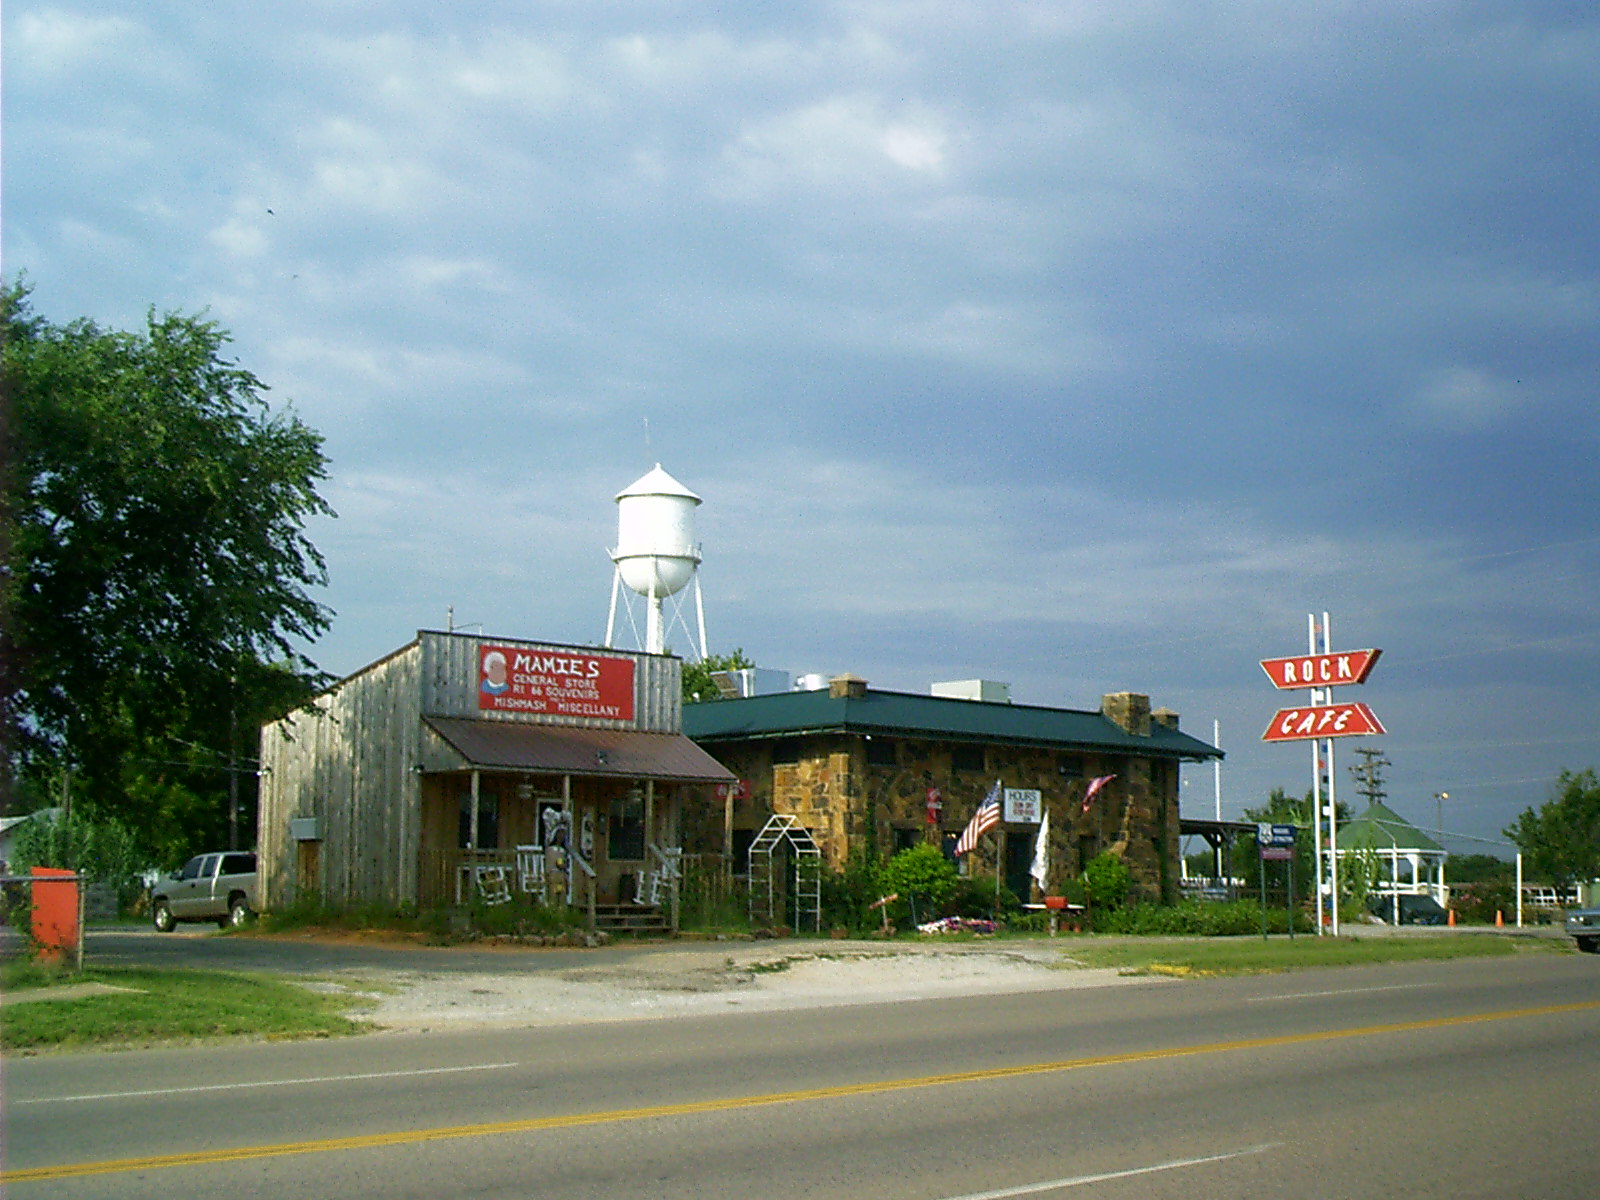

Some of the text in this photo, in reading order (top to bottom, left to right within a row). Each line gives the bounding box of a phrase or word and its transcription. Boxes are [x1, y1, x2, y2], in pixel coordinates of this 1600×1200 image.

[513, 653, 600, 678] MAMIES
[1284, 656, 1352, 683] ROCK
[531, 686, 543, 697] 66
[545, 687, 600, 700] SOUVENIRS
[565, 678, 596, 690] STORE
[494, 697, 547, 711] MISHMASH
[558, 702, 621, 717] MISCELLANY
[1281, 710, 1353, 734] CAFE
[1008, 790, 1037, 802] HOURS
